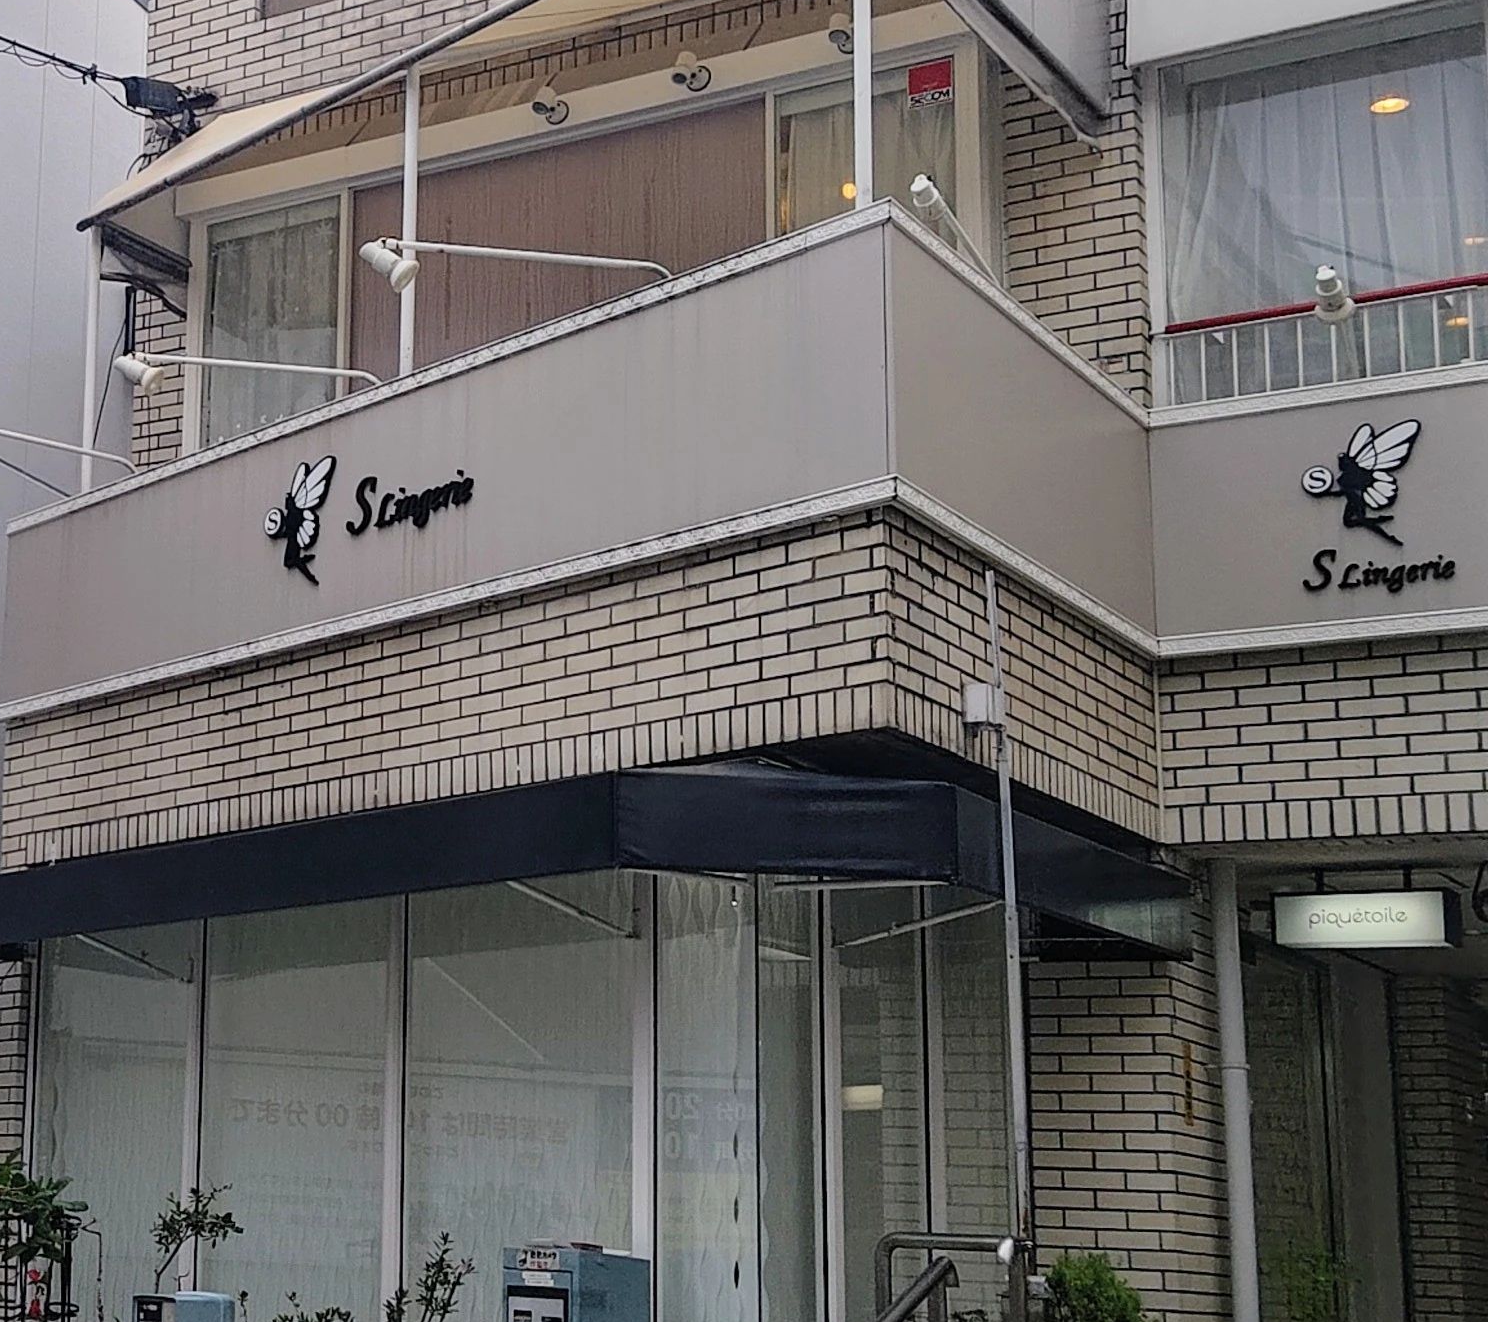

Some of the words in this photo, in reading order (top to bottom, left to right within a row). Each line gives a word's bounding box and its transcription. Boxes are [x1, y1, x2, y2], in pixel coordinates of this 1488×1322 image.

[345, 475, 378, 536] S
[373, 469, 475, 529] Lingerie
[1302, 548, 1337, 592] S
[1337, 554, 1457, 594] Lingerie
